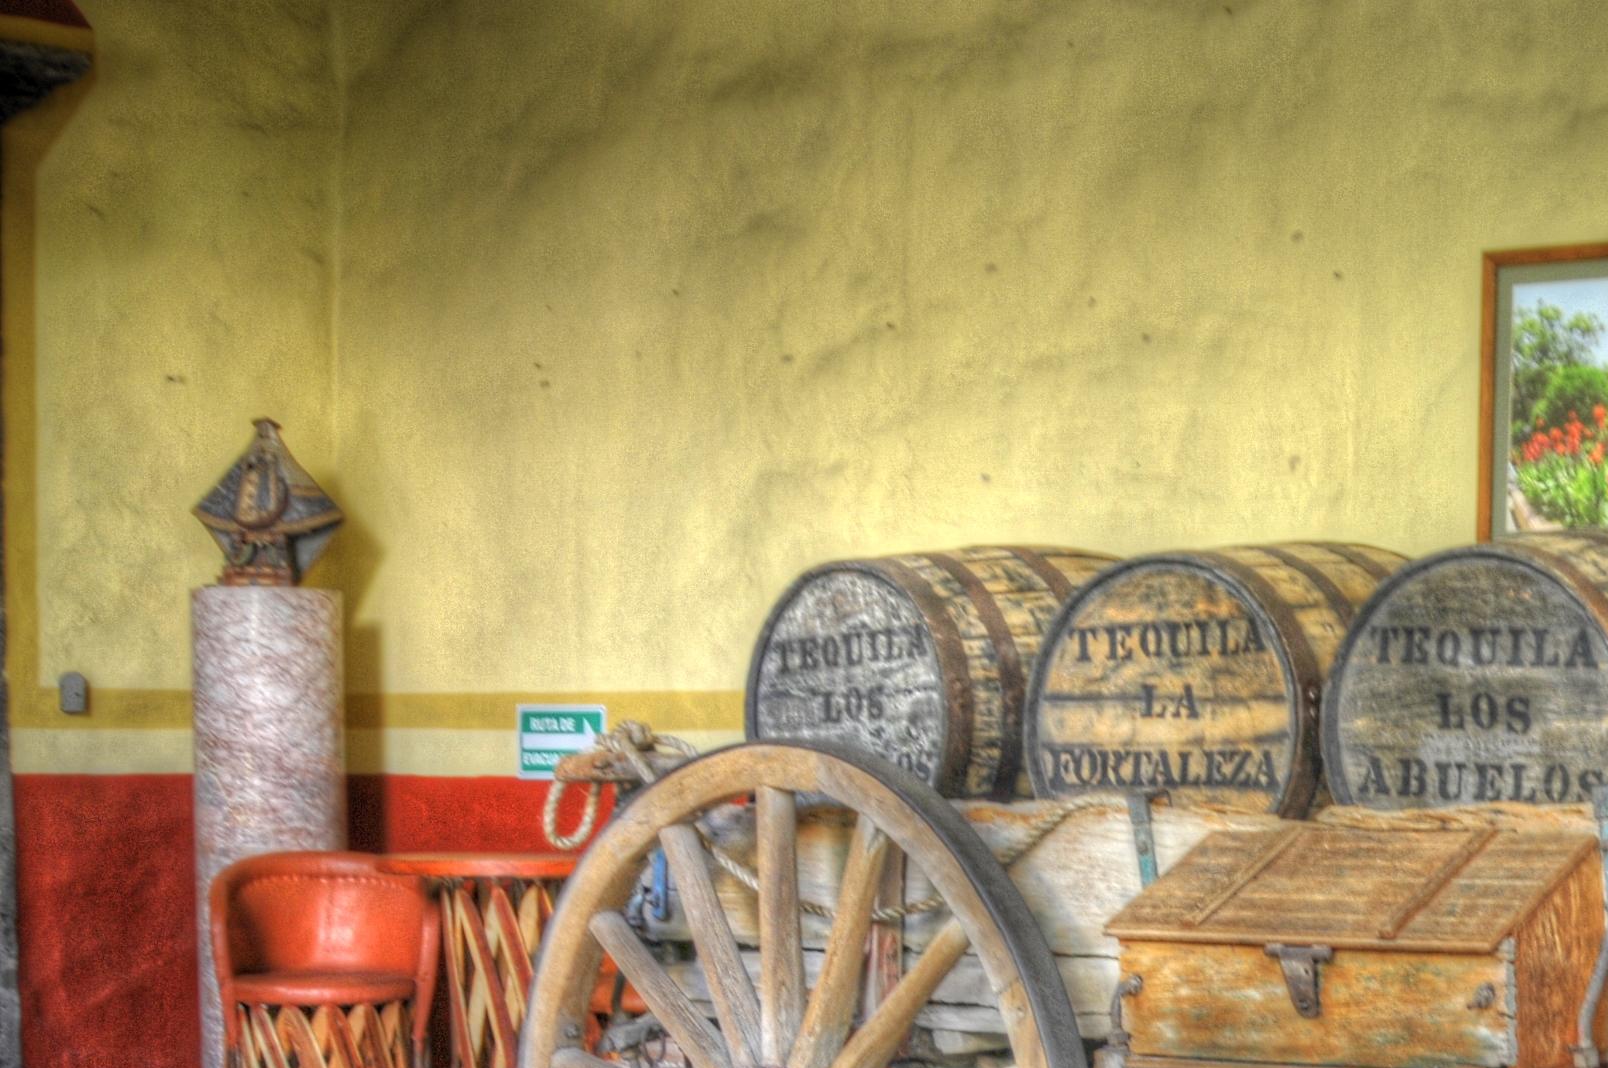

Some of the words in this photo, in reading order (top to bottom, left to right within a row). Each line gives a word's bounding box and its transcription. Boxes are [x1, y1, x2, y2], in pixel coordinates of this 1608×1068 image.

[775, 623, 928, 674] TEQUILA
[1067, 616, 1267, 662] TEQUILA
[1370, 625, 1598, 668] TEQUILA
[822, 684, 884, 723] LOS
[1139, 683, 1199, 719] LA
[1435, 691, 1532, 735] LOS
[529, 716, 559, 732] RUTA
[559, 716, 576, 732] DE
[1050, 749, 1281, 789] FORTALEZA
[1358, 756, 1604, 803] ABUELOS
